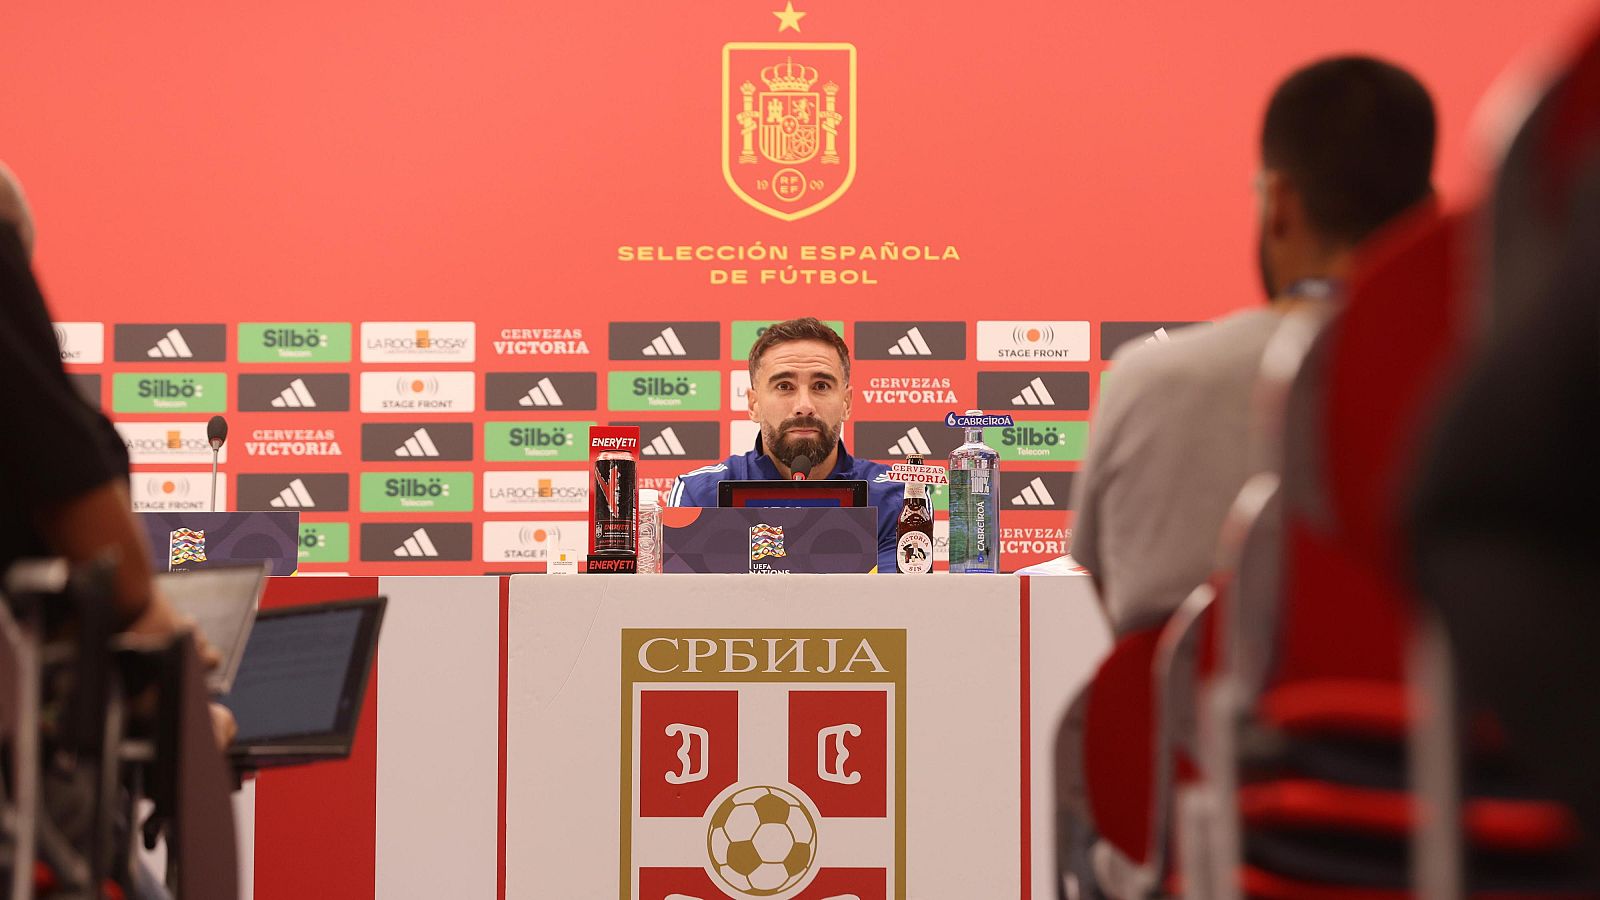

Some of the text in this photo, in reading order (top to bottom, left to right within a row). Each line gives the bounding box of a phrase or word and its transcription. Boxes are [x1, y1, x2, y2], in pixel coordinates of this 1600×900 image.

[617, 241, 961, 262] SELECCIÓN ESPAÑOLA
[709, 265, 878, 285] DE FÚTBOL
[500, 328, 582, 339] CERVEZAS
[493, 341, 590, 355] VICTORIA
[998, 349, 1069, 358] STAGE FRONT
[869, 377, 951, 389] CERVEZAS
[862, 390, 958, 404] VICTORIA
[381, 400, 453, 409] STAGE FRONT
[252, 430, 335, 441] CERVEZAS
[245, 442, 342, 456] VICTORIA
[591, 437, 637, 449] ENERYETI
[1016, 447, 1050, 456] Telecom
[893, 464, 944, 475] CERVEZAS
[888, 472, 948, 484] VICTORIA
[1000, 528, 1073, 539] ERVEZAS
[504, 549, 537, 558] STAGE
[1000, 541, 1073, 554] ICTORI
[589, 560, 635, 570] ENERYETI
[638, 637, 890, 674] СРБИЈА
